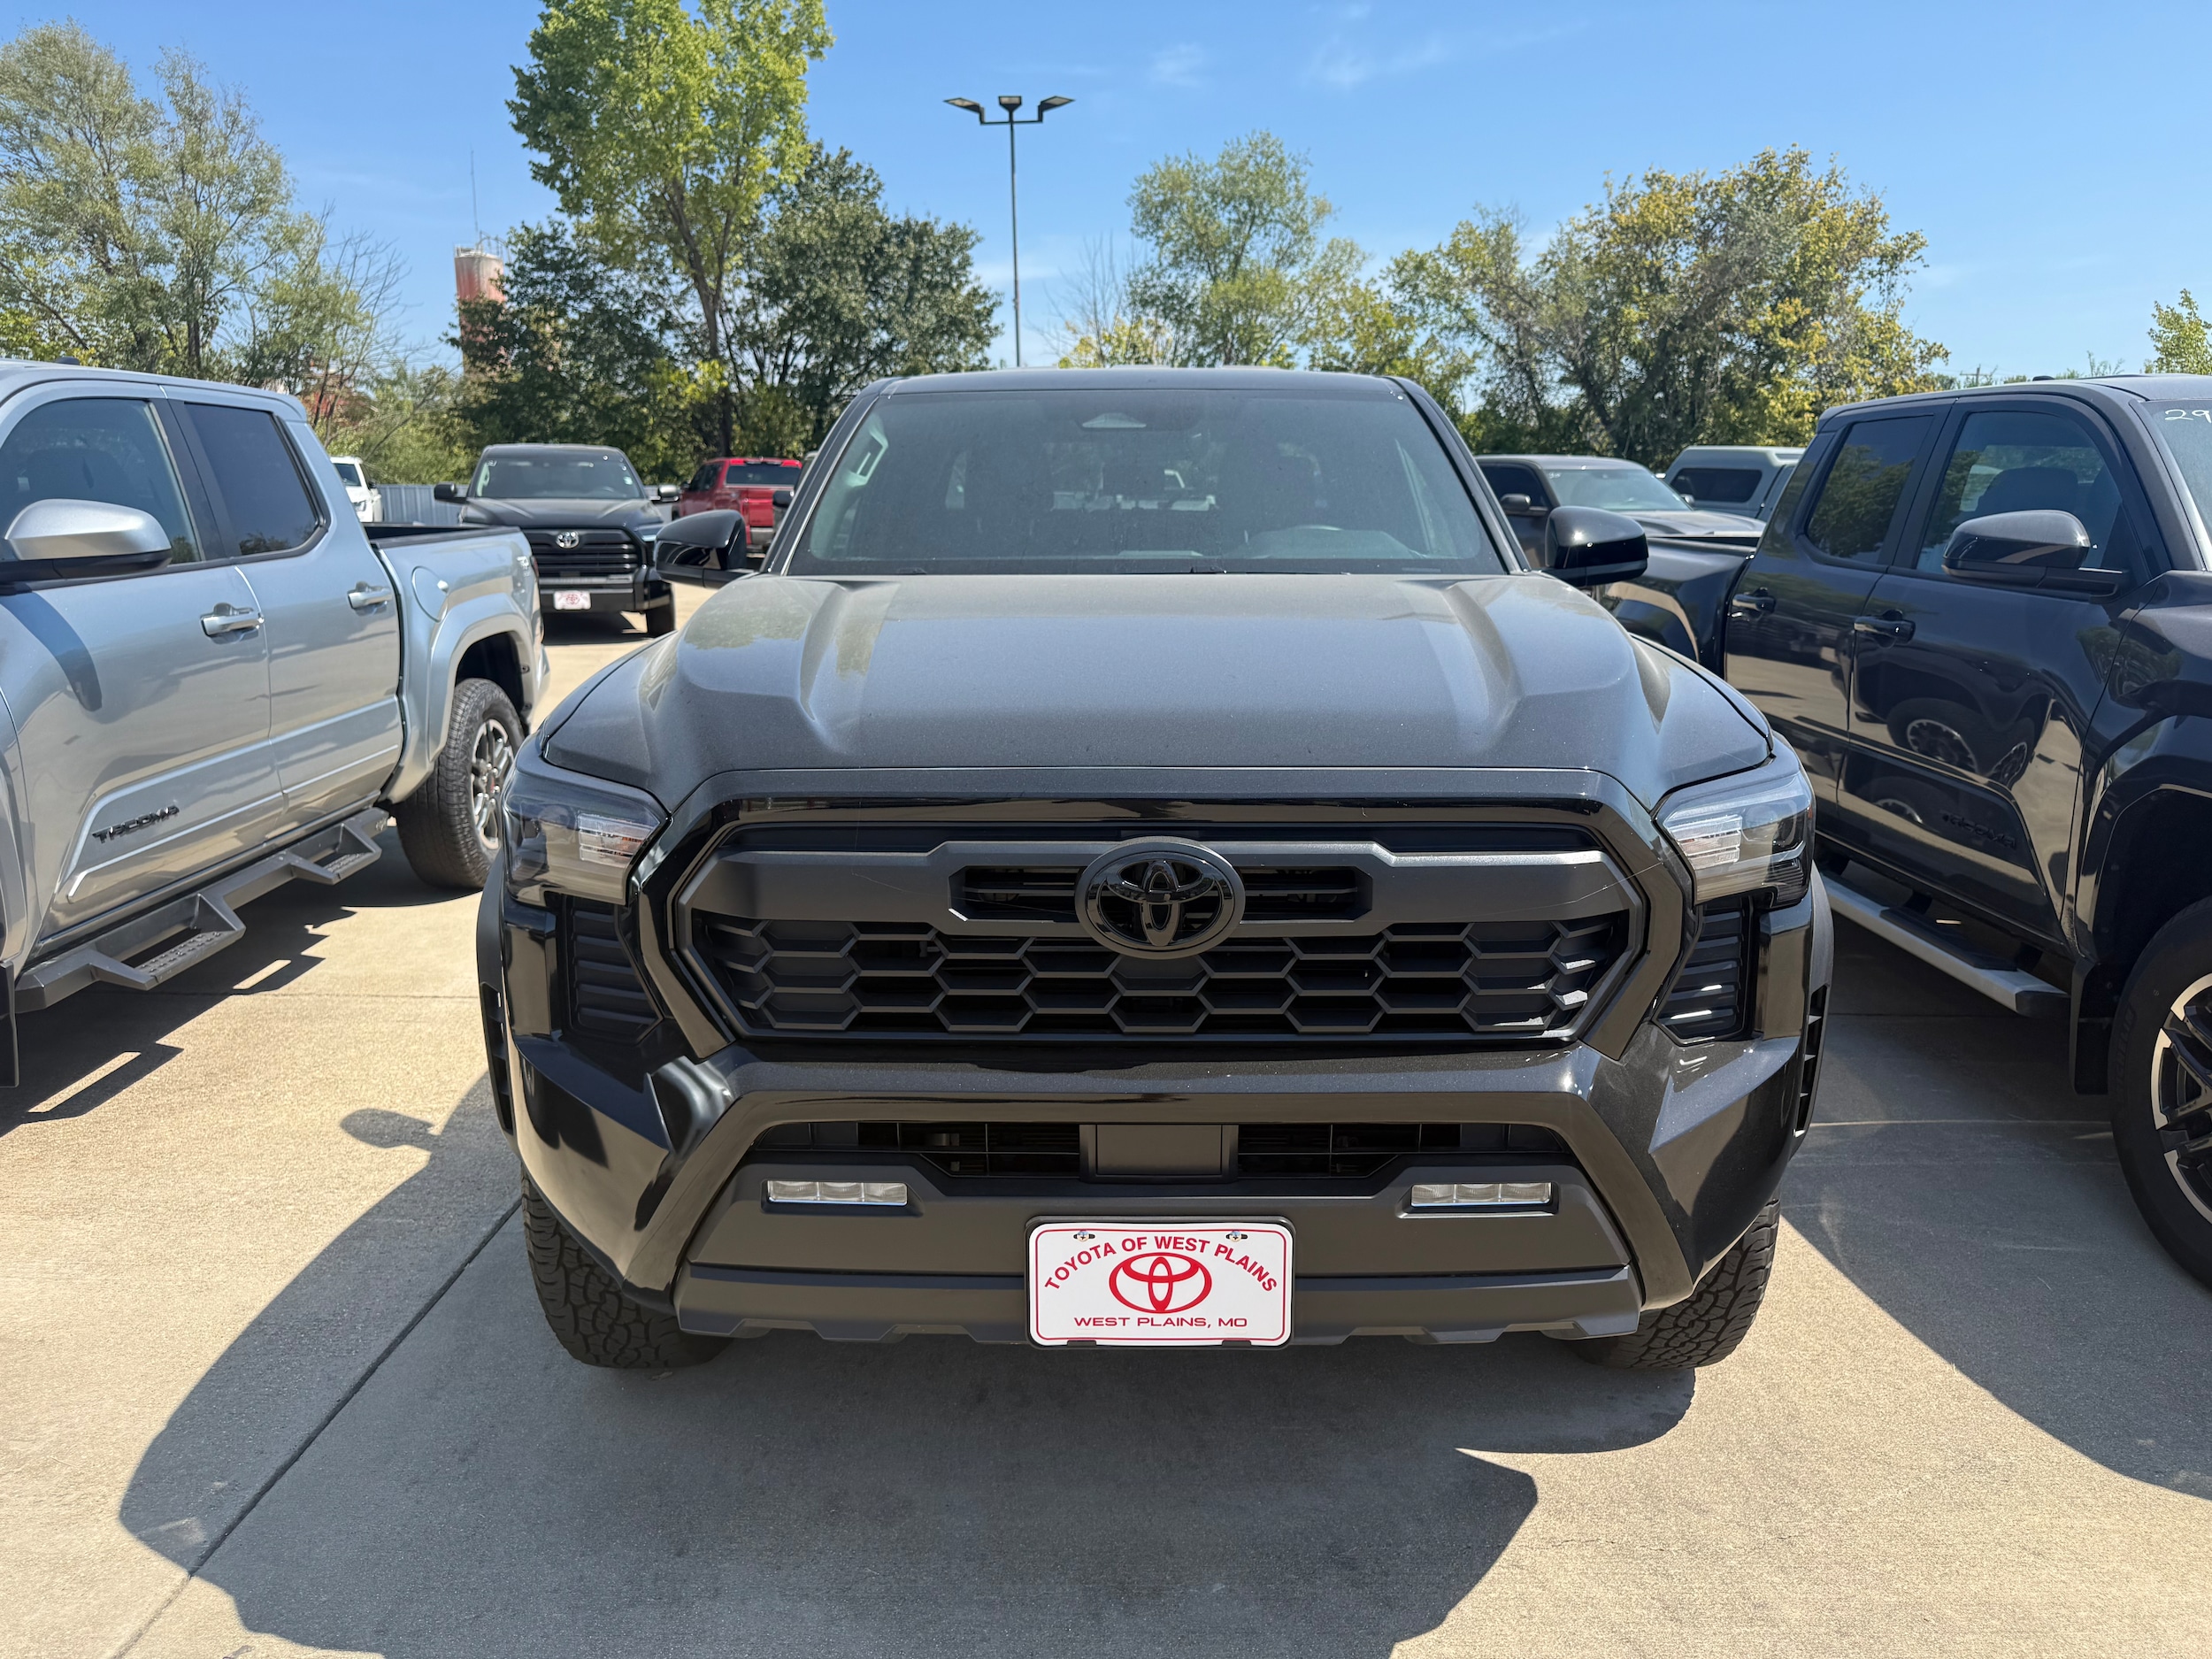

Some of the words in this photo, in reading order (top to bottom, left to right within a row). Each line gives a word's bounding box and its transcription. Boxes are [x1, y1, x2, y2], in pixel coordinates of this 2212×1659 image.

[1044, 1241, 1117, 1291] TOYOTA
[1121, 1236, 1148, 1252] OF
[1154, 1236, 1210, 1253] WEST
[1214, 1243, 1278, 1293] PLAINS
[1073, 1317, 1131, 1327] WEST
[1137, 1317, 1211, 1329] PLAINS,
[1217, 1317, 1248, 1327] MO
